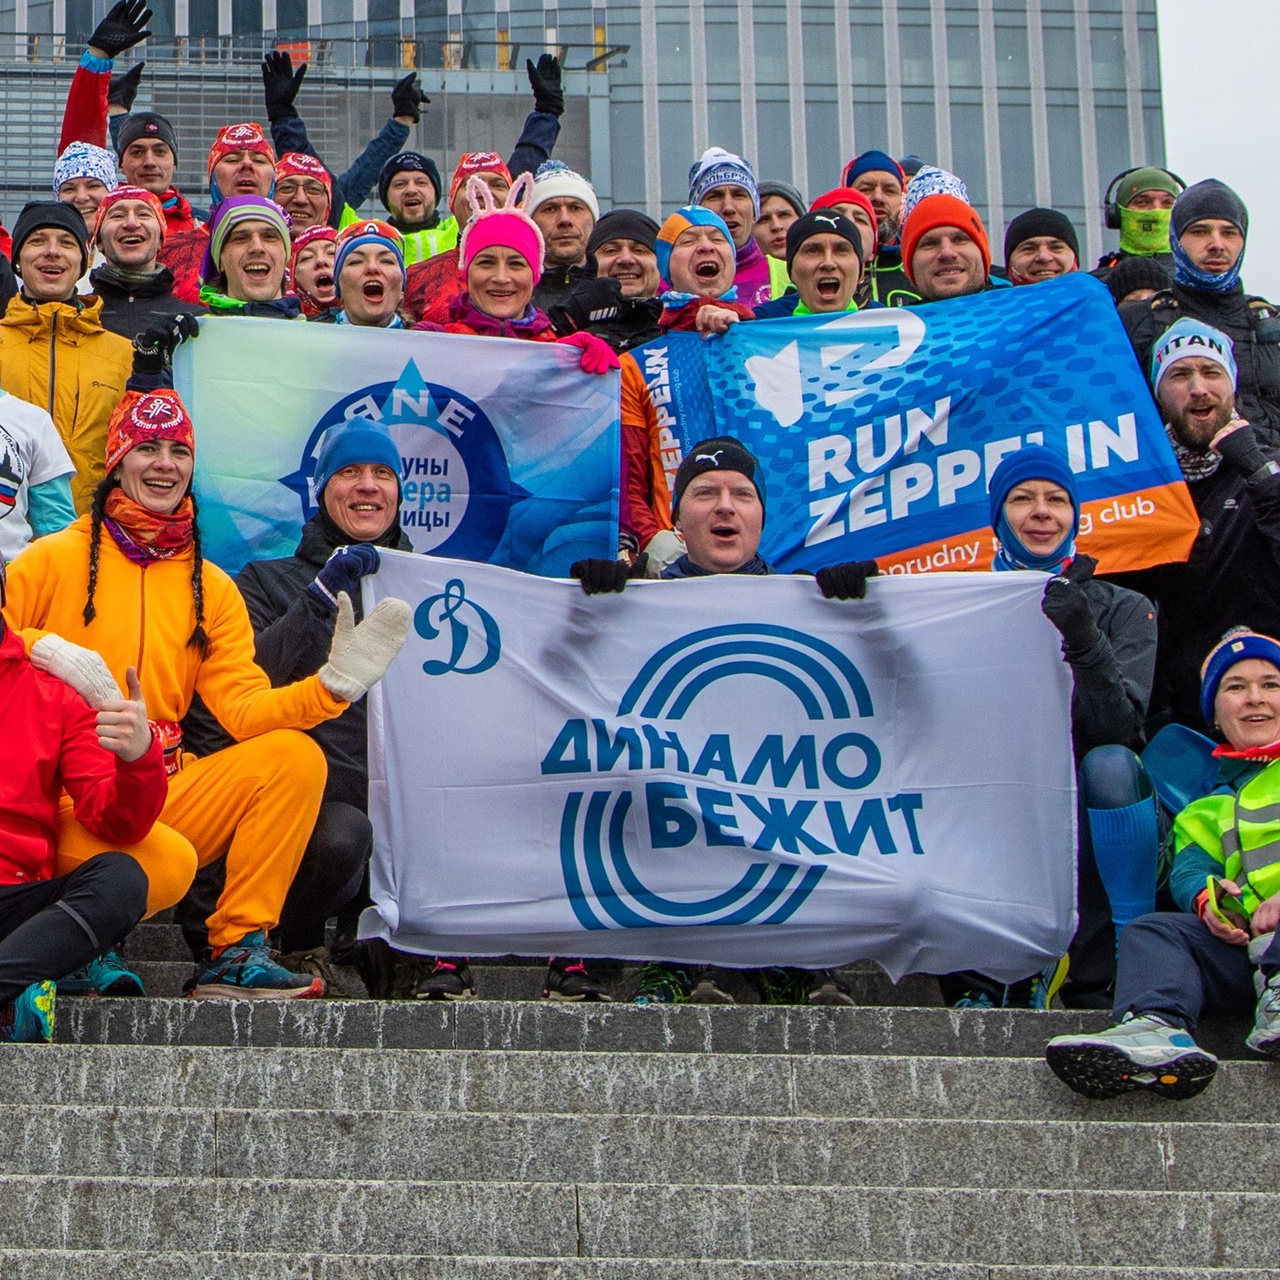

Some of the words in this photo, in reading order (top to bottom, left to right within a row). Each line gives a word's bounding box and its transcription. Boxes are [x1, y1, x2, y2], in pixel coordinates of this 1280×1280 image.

[805, 412, 1139, 548] ZEPPEIN
[808, 395, 951, 492] RUN
[1100, 496, 1155, 523] club
[540, 718, 882, 790] ДИНАМО
[645, 781, 924, 857] БЕЖИТ
